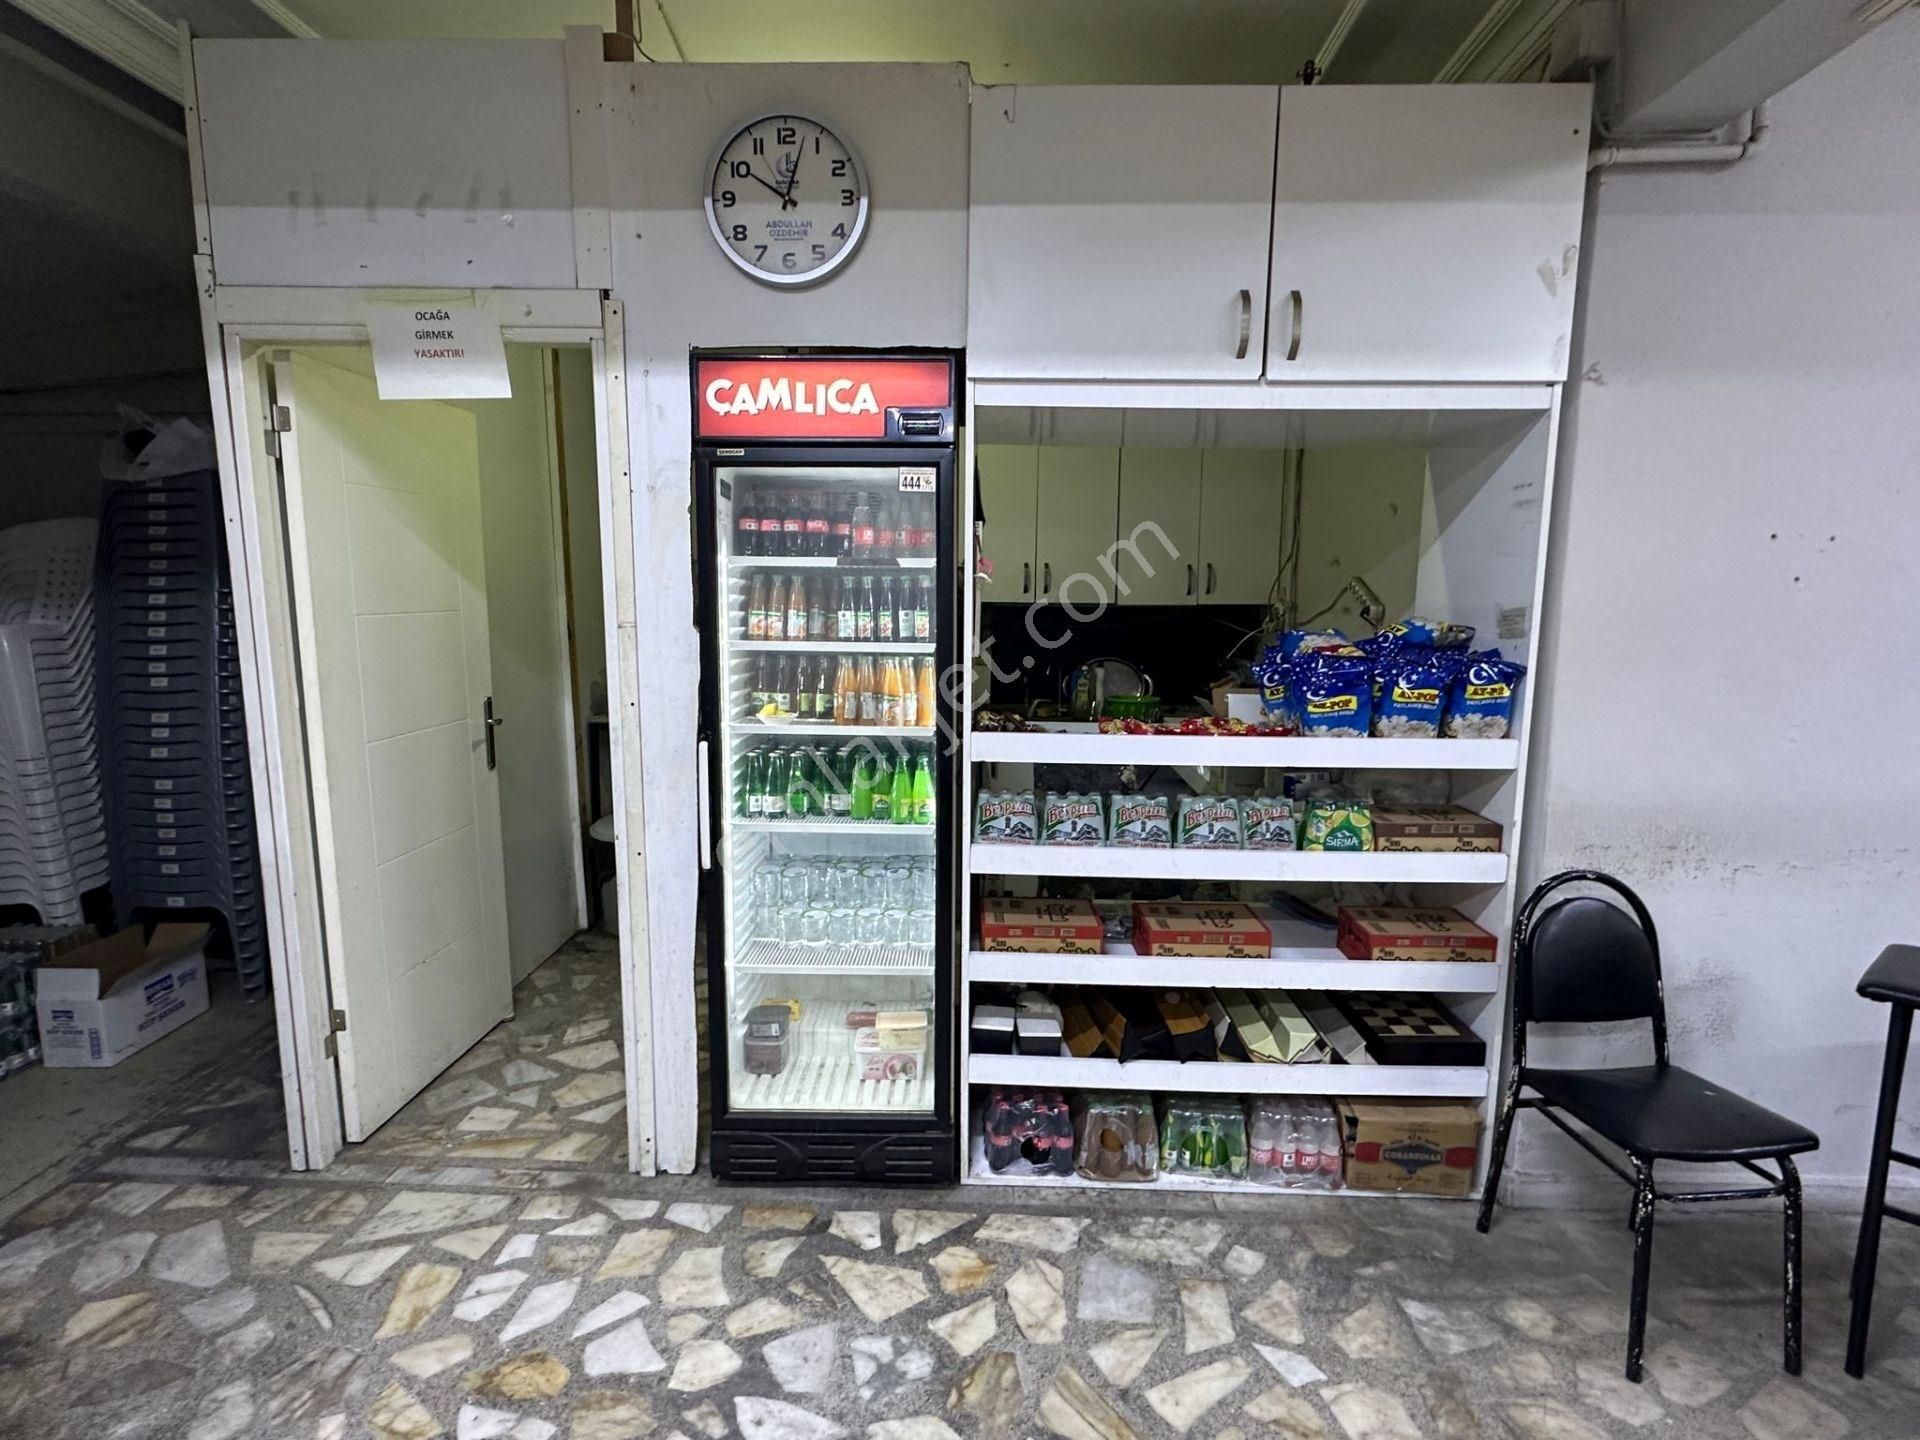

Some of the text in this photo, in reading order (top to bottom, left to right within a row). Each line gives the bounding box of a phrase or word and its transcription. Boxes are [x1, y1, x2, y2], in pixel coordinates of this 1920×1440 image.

[777, 127, 796, 145] 12
[753, 137, 764, 155] 11
[815, 137, 820, 154] 1
[730, 161, 751, 178] 10
[831, 160, 846, 177] 2
[721, 190, 736, 208] 9
[840, 189, 854, 206] 3
[732, 224, 748, 241] 8
[766, 219, 812, 229] ABDULLAH
[831, 222, 846, 240] 4
[754, 244, 768, 262] 7
[782, 252, 796, 269] 6
[811, 244, 826, 261] 5
[415, 310, 451, 321] OCAĞA
[415, 329, 454, 340] GİRMEK
[414, 348, 465, 359] YASAKTIR!
[705, 377, 879, 417] ÇAMLICA
[901, 475, 921, 490] 444
